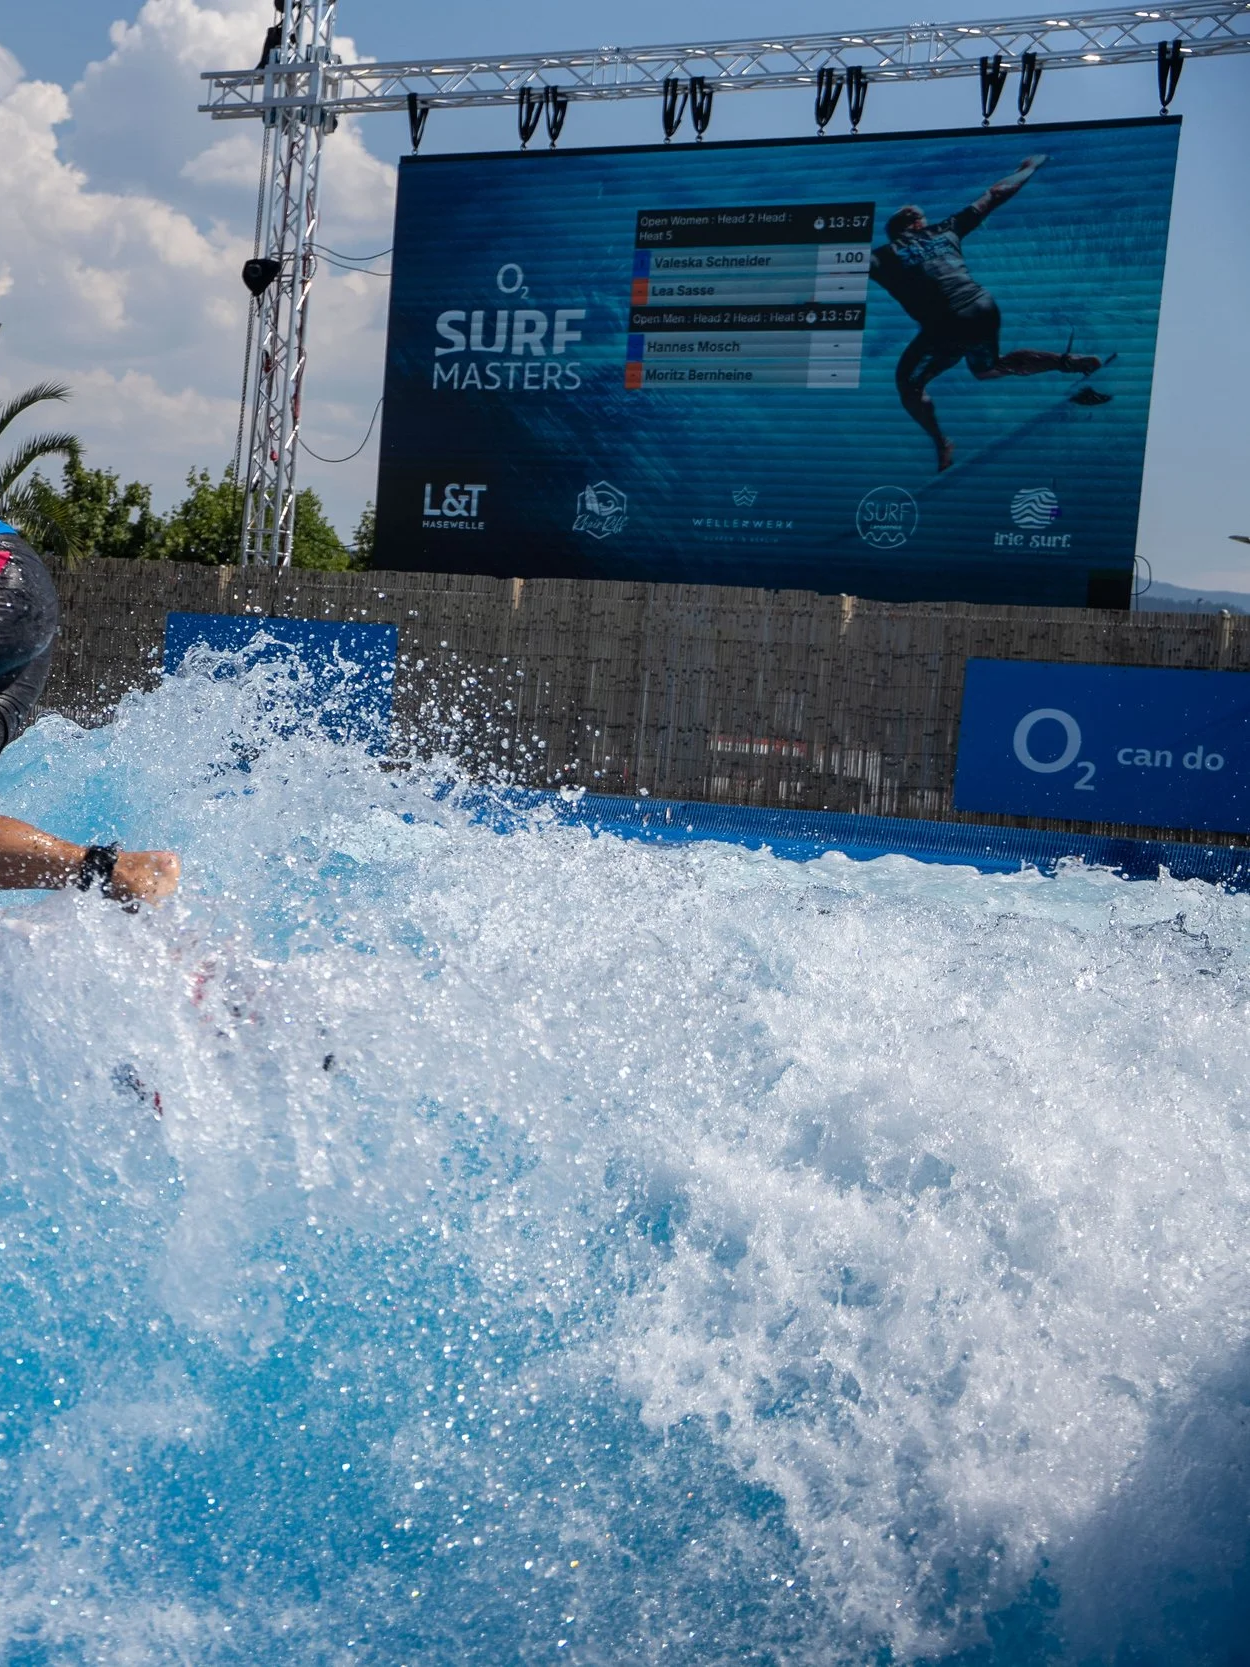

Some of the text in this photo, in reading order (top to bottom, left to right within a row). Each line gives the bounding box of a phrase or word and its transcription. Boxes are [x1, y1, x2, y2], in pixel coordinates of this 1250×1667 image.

[640, 217, 668, 229] Open
[670, 215, 709, 226] Women
[717, 213, 746, 224] Head
[748, 213, 756, 223] 2
[757, 212, 786, 223] Head
[828, 215, 870, 229] 13:57
[639, 230, 673, 241] Heat 5
[654, 255, 771, 269] Valeska Schneider
[835, 252, 864, 264] 1.00
[651, 285, 715, 297] Lea Sasse
[632, 313, 661, 326] Open
[662, 313, 685, 324] Men
[693, 312, 720, 324] Head
[723, 312, 731, 323] 2
[733, 312, 761, 323] Head
[770, 312, 796, 323] Heat
[797, 312, 805, 323] 5
[820, 309, 862, 323] 13:57
[435, 309, 587, 357] SURF
[647, 341, 740, 353] Hannes Mosch
[432, 361, 582, 391] MASTERS
[645, 370, 685, 381] Moritz
[423, 483, 487, 517] L&T
[862, 502, 912, 522] SURF
[422, 520, 485, 530] HASEWELLE
[993, 532, 1024, 546] irie
[1116, 747, 1173, 768] can
[1182, 745, 1225, 771] do
